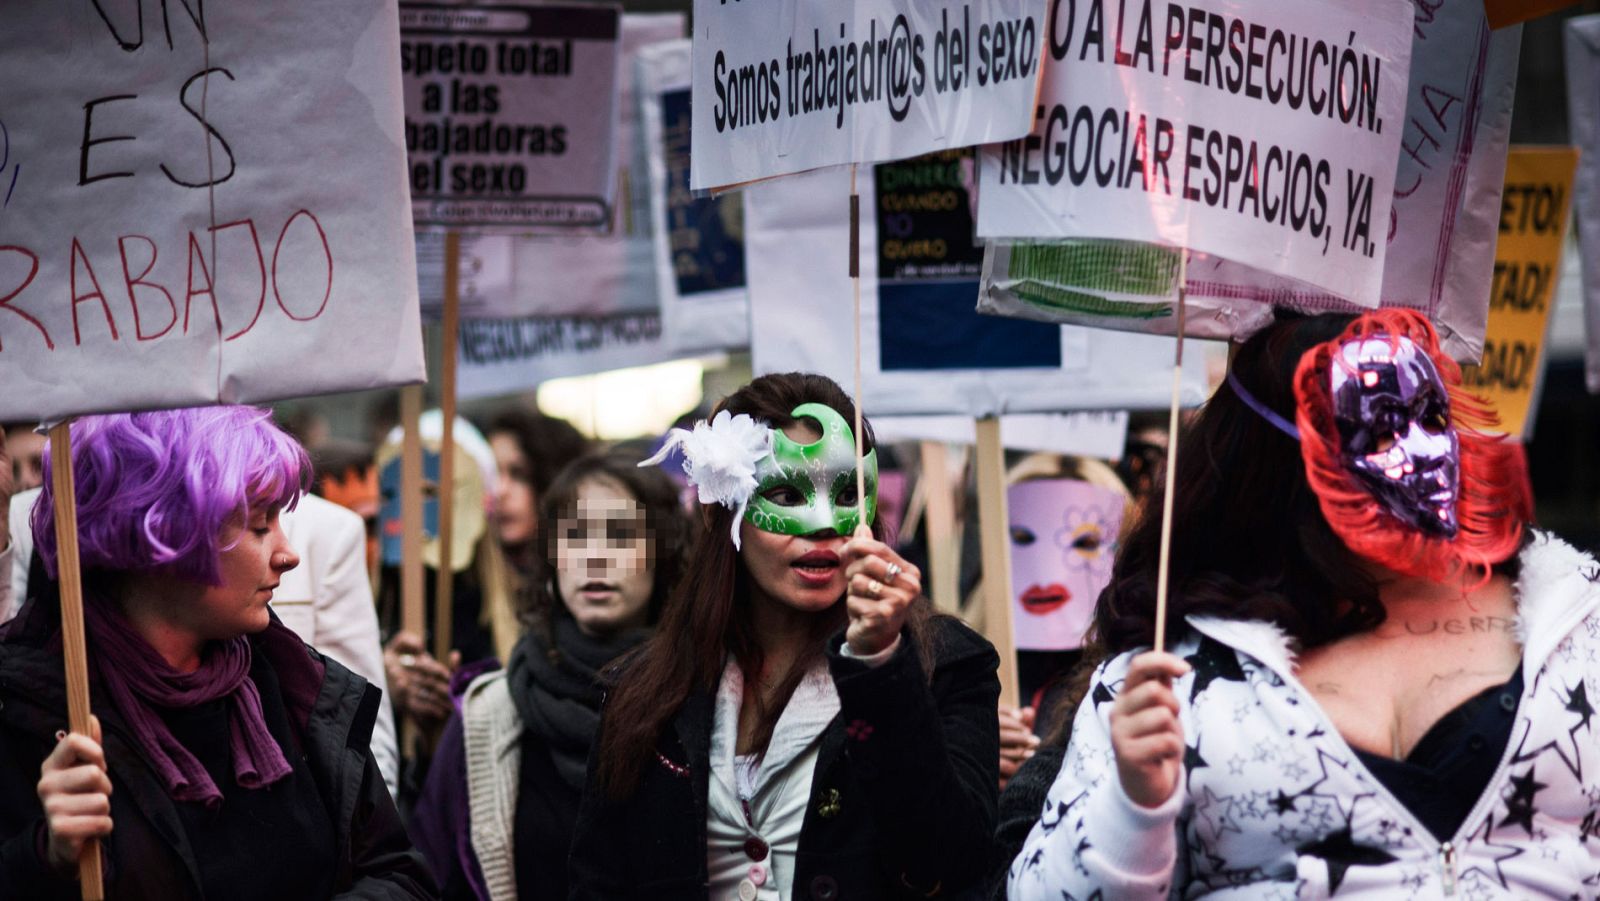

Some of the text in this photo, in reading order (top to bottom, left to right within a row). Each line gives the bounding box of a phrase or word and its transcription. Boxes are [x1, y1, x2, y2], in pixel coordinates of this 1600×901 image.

[401, 38, 573, 76] speto total
[713, 50, 780, 134] Somos
[787, 14, 926, 130] trabajadr@s
[934, 4, 970, 95] del
[1049, 0, 1075, 61] O
[1080, 0, 1104, 63] A
[1114, 0, 1155, 73] LA
[1164, 2, 1383, 135] PERSECUCIÓN.
[423, 79, 500, 115] a las
[77, 67, 236, 189] ES
[405, 119, 567, 156] bajadoras
[412, 158, 527, 193] el sexo
[1000, 104, 1376, 258] NEGOCIAR ESPACIOS, YA.
[1499, 183, 1564, 234] ETO!
[0, 209, 333, 351] RABAJO
[1489, 260, 1551, 312] TAD!
